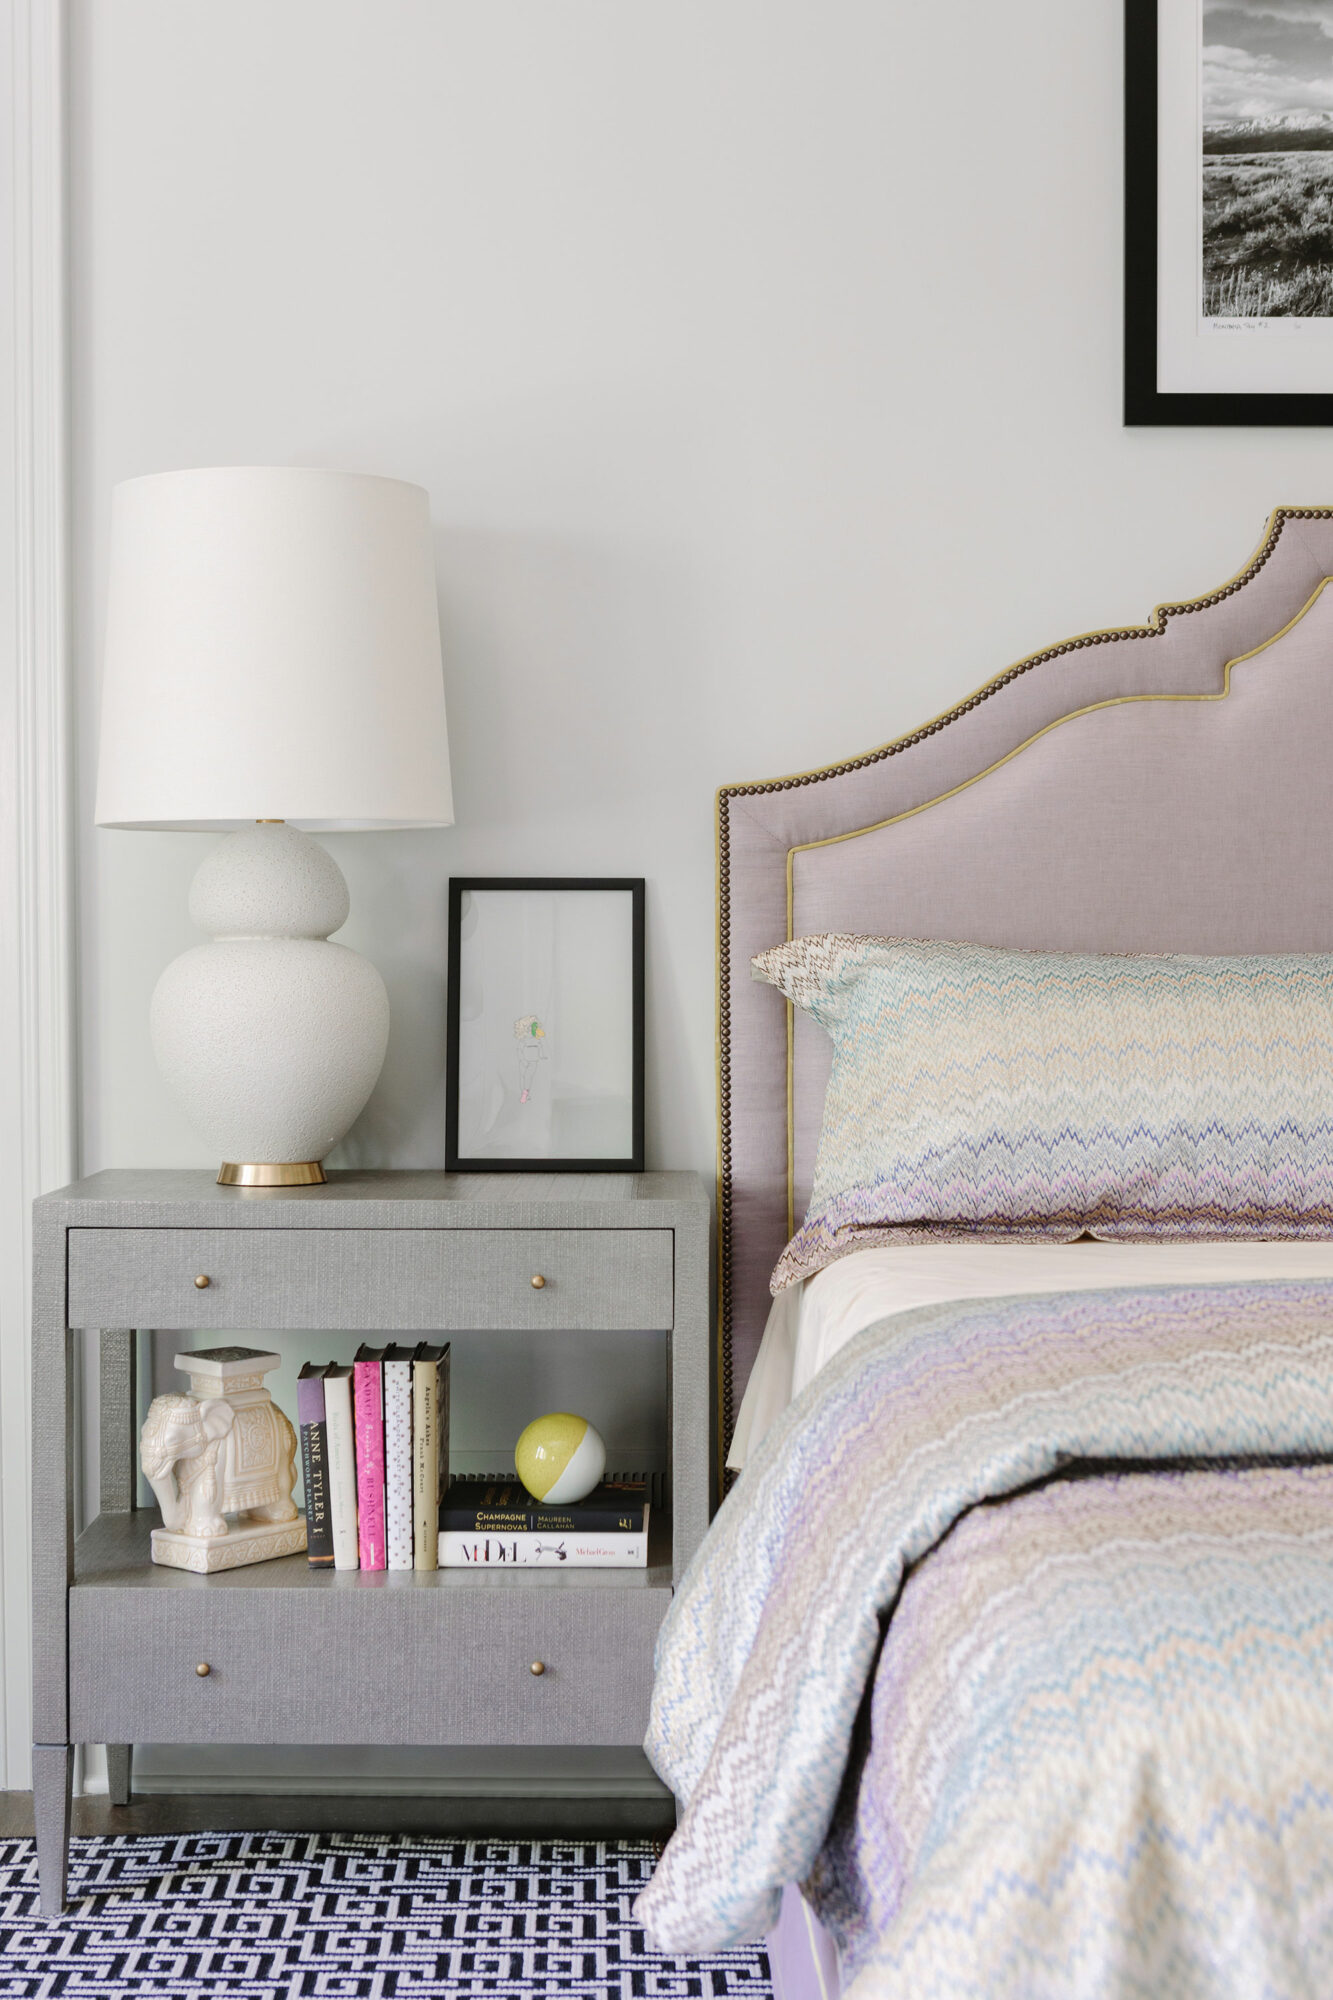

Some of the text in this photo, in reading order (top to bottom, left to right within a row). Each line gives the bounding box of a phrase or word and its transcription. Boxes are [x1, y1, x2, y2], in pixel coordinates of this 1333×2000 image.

[424, 1386, 432, 1420] Angela's
[303, 1431, 311, 1485] PATCHWORK
[310, 1420, 321, 1463] ANNE
[306, 1488, 314, 1522] PLANET
[312, 1470, 325, 1522] TYLER
[366, 1478, 376, 1537] BUSHNELL
[475, 1521, 528, 1531] SUPERNOVAS
[476, 1511, 527, 1522] CHAMPAGNE
